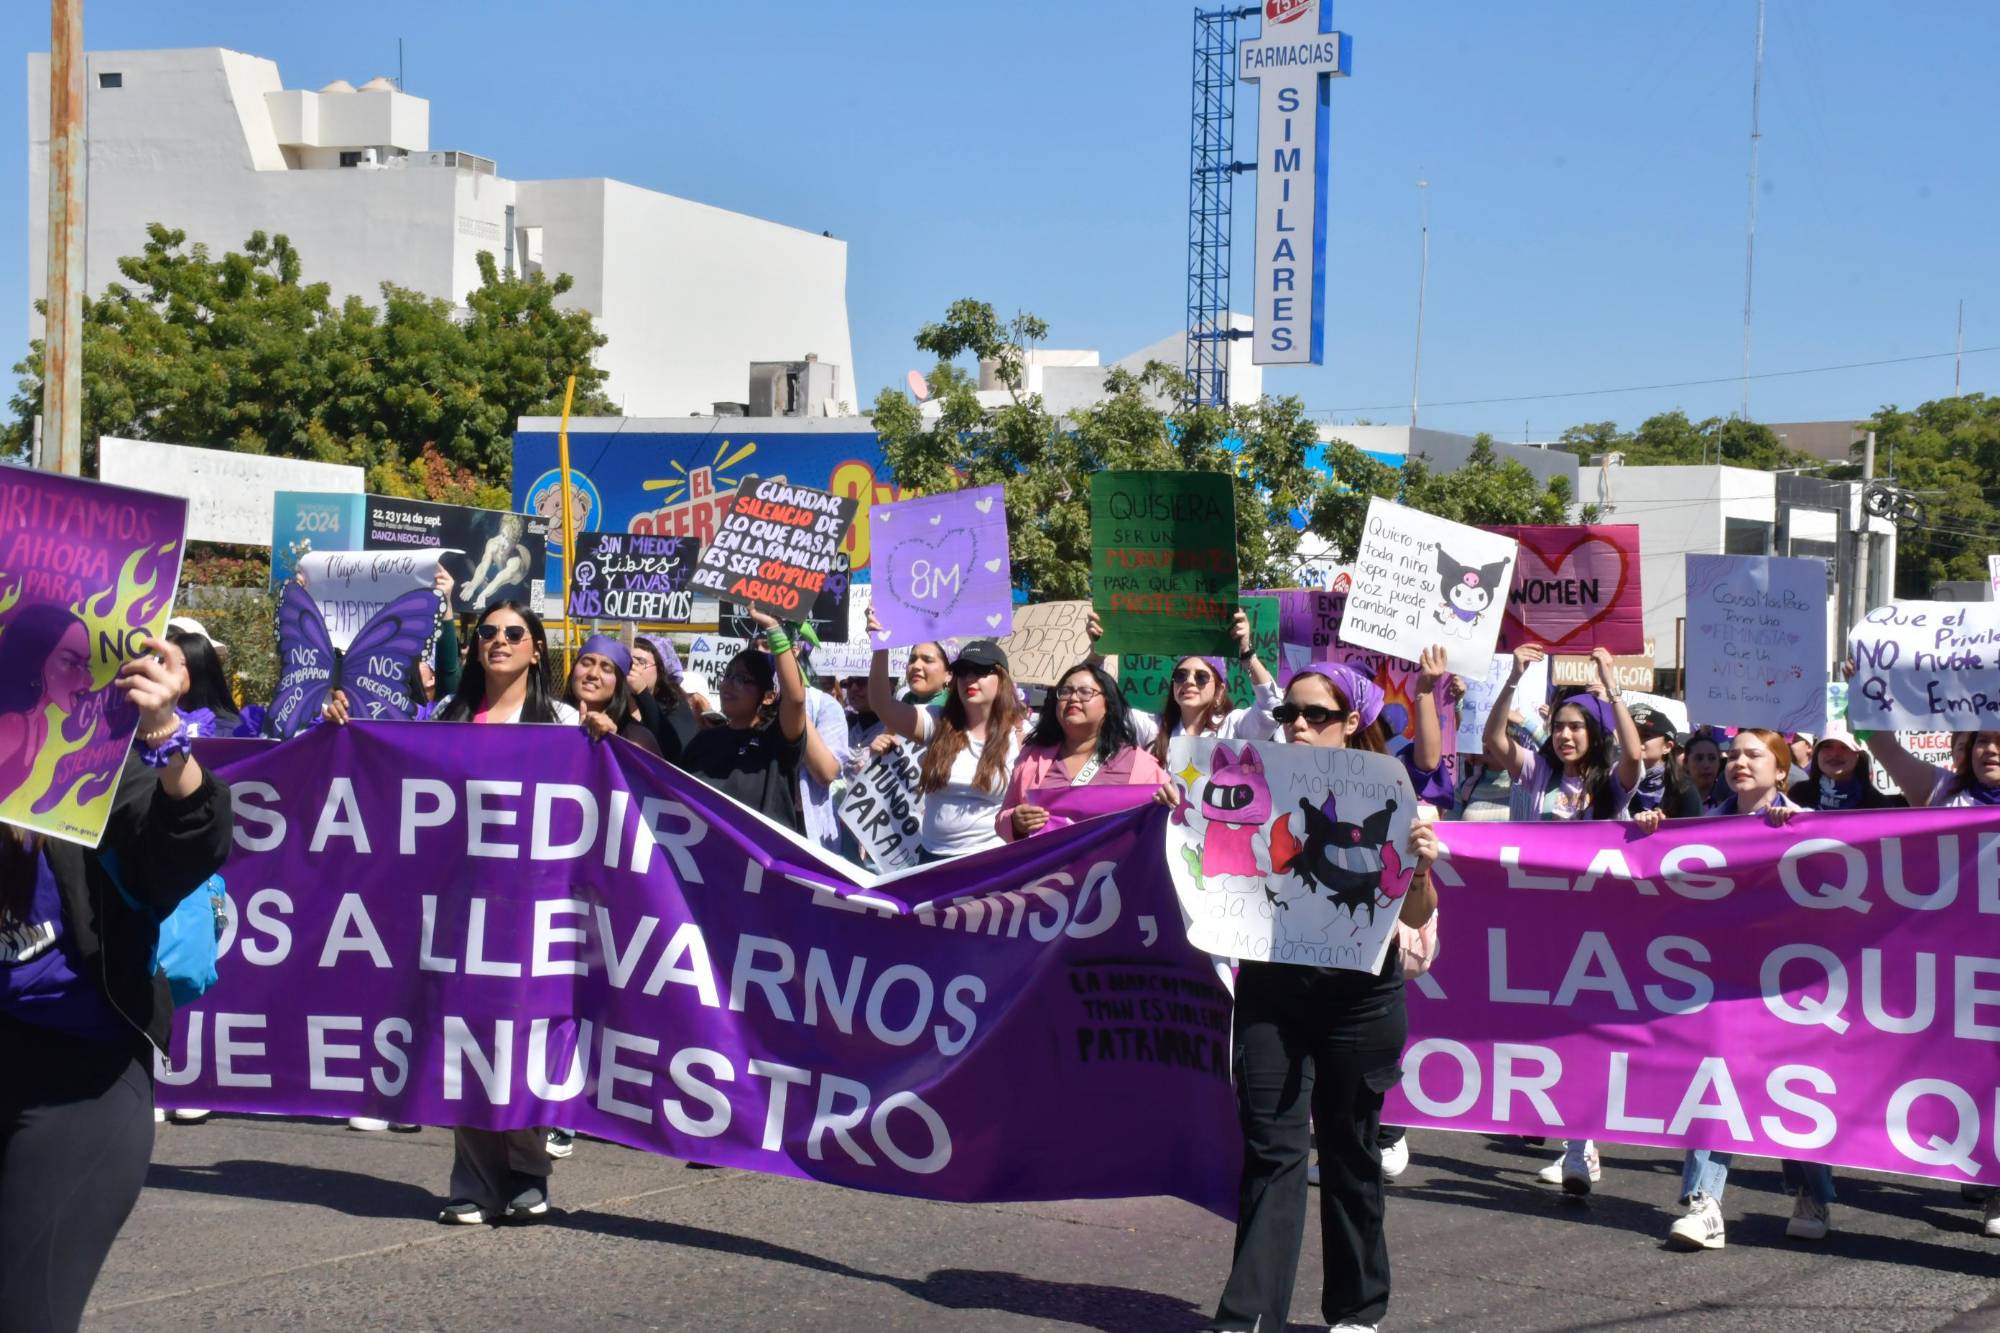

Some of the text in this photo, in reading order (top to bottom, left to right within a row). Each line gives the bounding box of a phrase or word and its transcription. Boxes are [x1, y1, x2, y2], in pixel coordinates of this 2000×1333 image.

[1245, 42, 1334, 69] FARMACIAS
[1270, 87, 1302, 353] SIMILARES
[692, 469, 712, 498] EL
[756, 482, 842, 516] GUARDAR
[1109, 491, 1223, 521] QUISIERA
[295, 511, 341, 533] 2024
[372, 509, 385, 520] 22,
[386, 511, 396, 522] 23
[401, 513, 412, 525] 24
[413, 513, 423, 525] de
[424, 515, 442, 528] sept.
[735, 496, 844, 538] SILENCIO DE
[371, 530, 441, 546] DANZA NEOCLÁSICA
[598, 535, 676, 556] SIN MIEDO
[724, 514, 836, 556] LO QUE PASA
[1113, 529, 1177, 544] SER UN
[1369, 516, 1433, 555] Quiero que
[5, 533, 110, 582] AHORA
[597, 554, 680, 575] Libres
[714, 531, 742, 550] EN
[741, 537, 764, 555] LA
[765, 542, 830, 573] FAMILIA
[1364, 540, 1393, 562] toda
[25, 569, 85, 602] PARA
[605, 574, 671, 591] Y VIVAS
[703, 548, 728, 568] ES
[728, 554, 760, 577] SER
[758, 560, 826, 593] CÓMPLICE
[911, 560, 960, 599] 8M
[1104, 576, 1218, 595] PARA QUE ME
[1361, 561, 1435, 592] sepa que su
[692, 569, 726, 590] DEL
[730, 577, 800, 610] ABUSO
[1356, 580, 1382, 596] voz
[1390, 590, 1426, 608] puede
[1509, 579, 1599, 605] WOMEN
[568, 590, 692, 620] NOS QUEREMOS
[1110, 592, 1228, 622] PROTEJAN
[1352, 596, 1420, 629] cambiar al
[1866, 605, 1966, 627] Que el
[99, 626, 154, 664] NO
[291, 644, 319, 667] NOS
[1723, 642, 1751, 659] Que
[1856, 639, 1900, 671] NO
[280, 667, 330, 692] SEMBRARON
[368, 655, 404, 681] NOS
[692, 659, 728, 675] MAES
[1012, 652, 1065, 681] SIN
[1554, 661, 1599, 684] VIOLENC
[356, 676, 411, 711] CRECIERON
[274, 686, 303, 732] MIEDO
[1314, 749, 1366, 776] Una
[864, 756, 920, 836] MUNDO
[1289, 772, 1403, 801] Motomami
[308, 777, 372, 854] A
[399, 777, 710, 885] PEDIR
[1498, 844, 1736, 900] LAS
[1232, 930, 1363, 965] Motomami
[318, 893, 393, 969] A
[419, 894, 988, 1056] LLEVARNOS
[1487, 927, 2000, 1042] LAS QUE
[154, 1010, 953, 1174] UE ES NUESTRO
[1401, 1037, 2000, 1177] OR LAS Q
